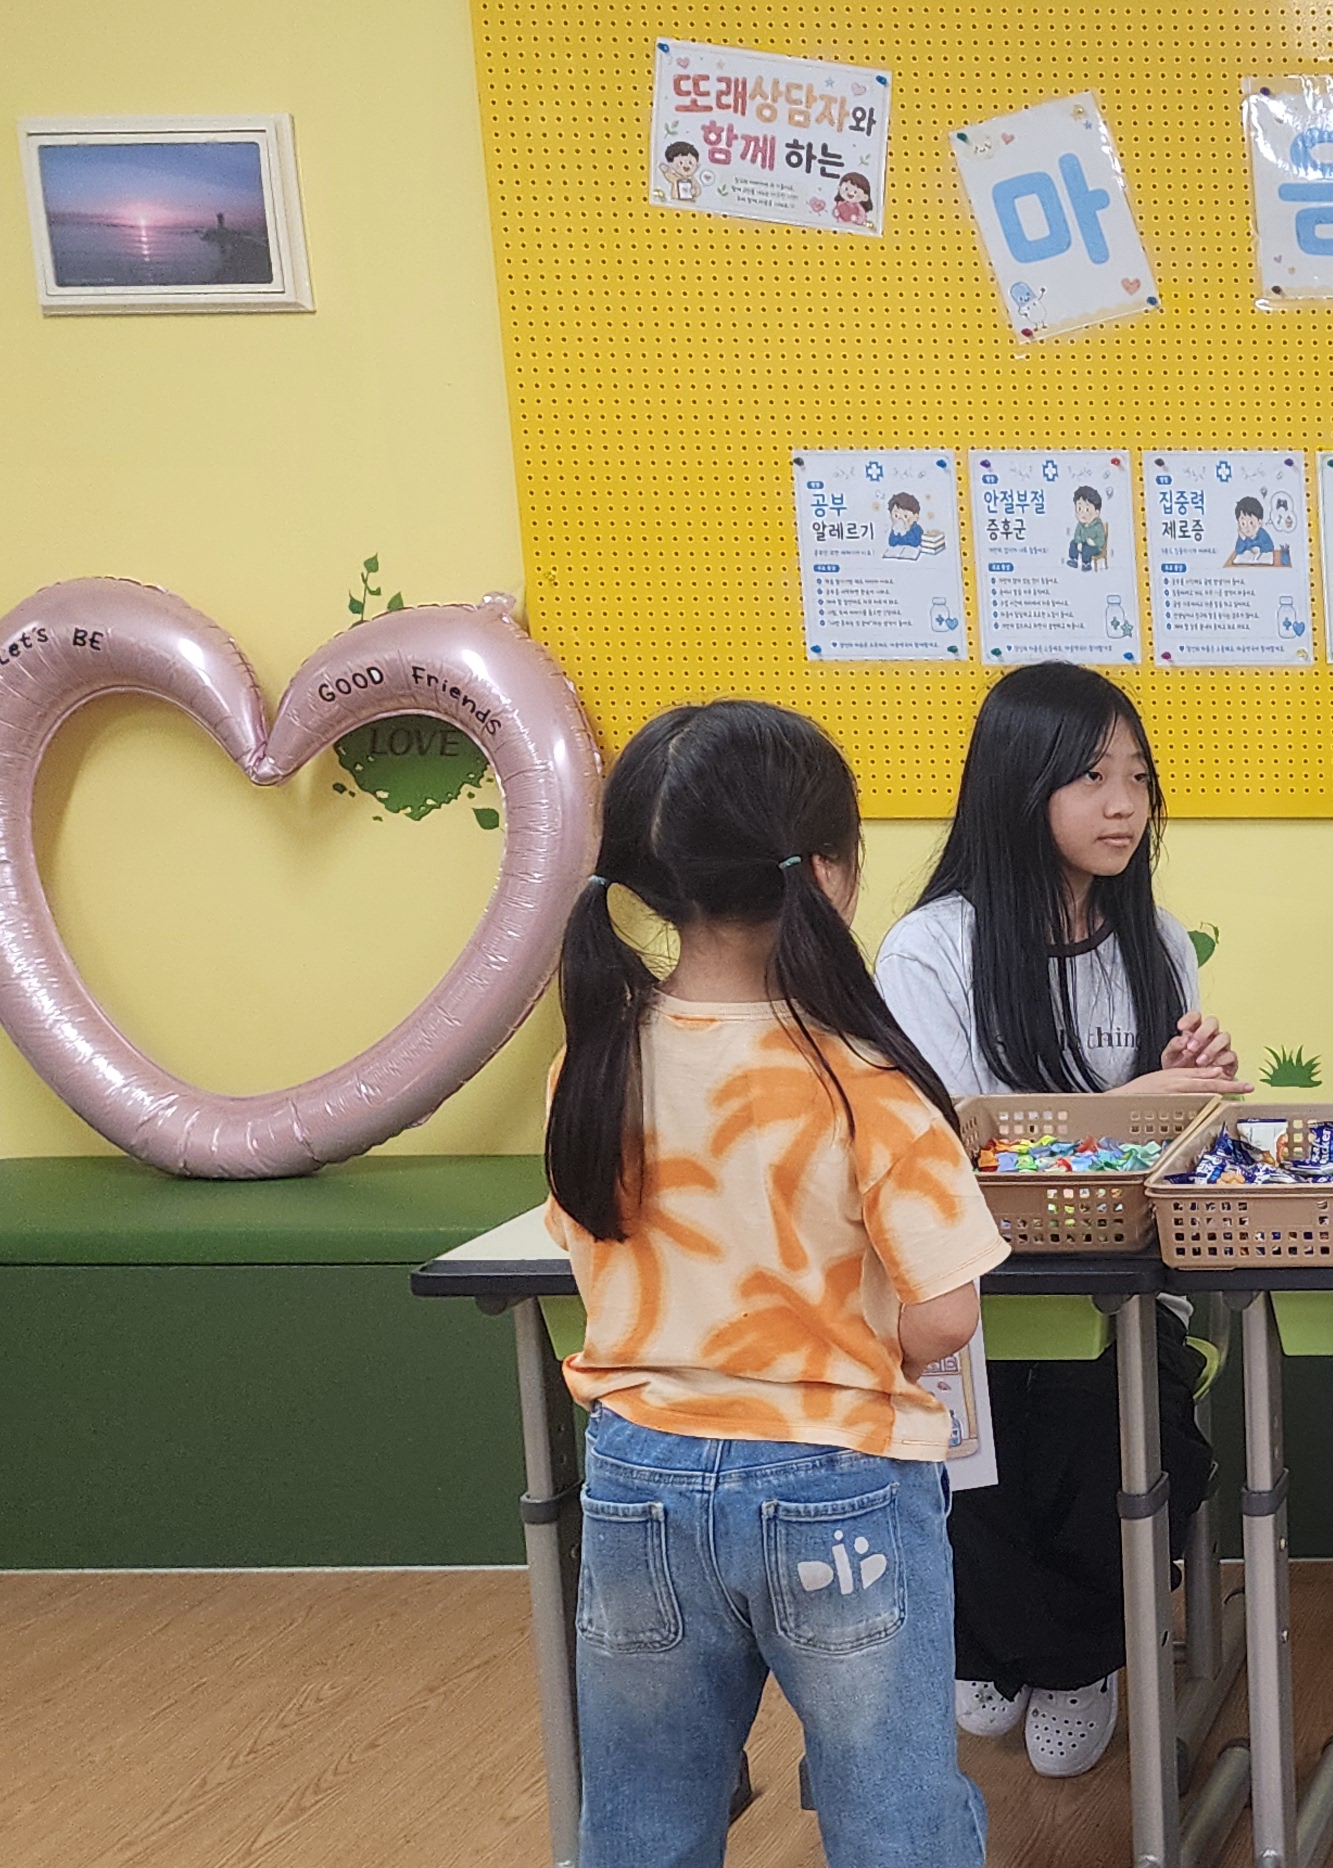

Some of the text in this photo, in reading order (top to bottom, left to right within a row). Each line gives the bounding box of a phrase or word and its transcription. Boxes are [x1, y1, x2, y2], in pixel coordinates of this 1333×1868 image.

[672, 73, 877, 137] 또래상담자와
[701, 119, 845, 180] 함께 하는
[991, 152, 1111, 267] 마
[810, 493, 847, 518] 공부
[984, 490, 1045, 514] 안절부절
[1159, 490, 1205, 515] 집중력
[812, 521, 875, 541] 알레르기
[986, 518, 1026, 541] 증후군
[1162, 519, 1205, 541] 제로증
[73, 627, 104, 651] BE
[318, 665, 501, 736] GOOD Friends
[370, 728, 459, 756] LOVE
